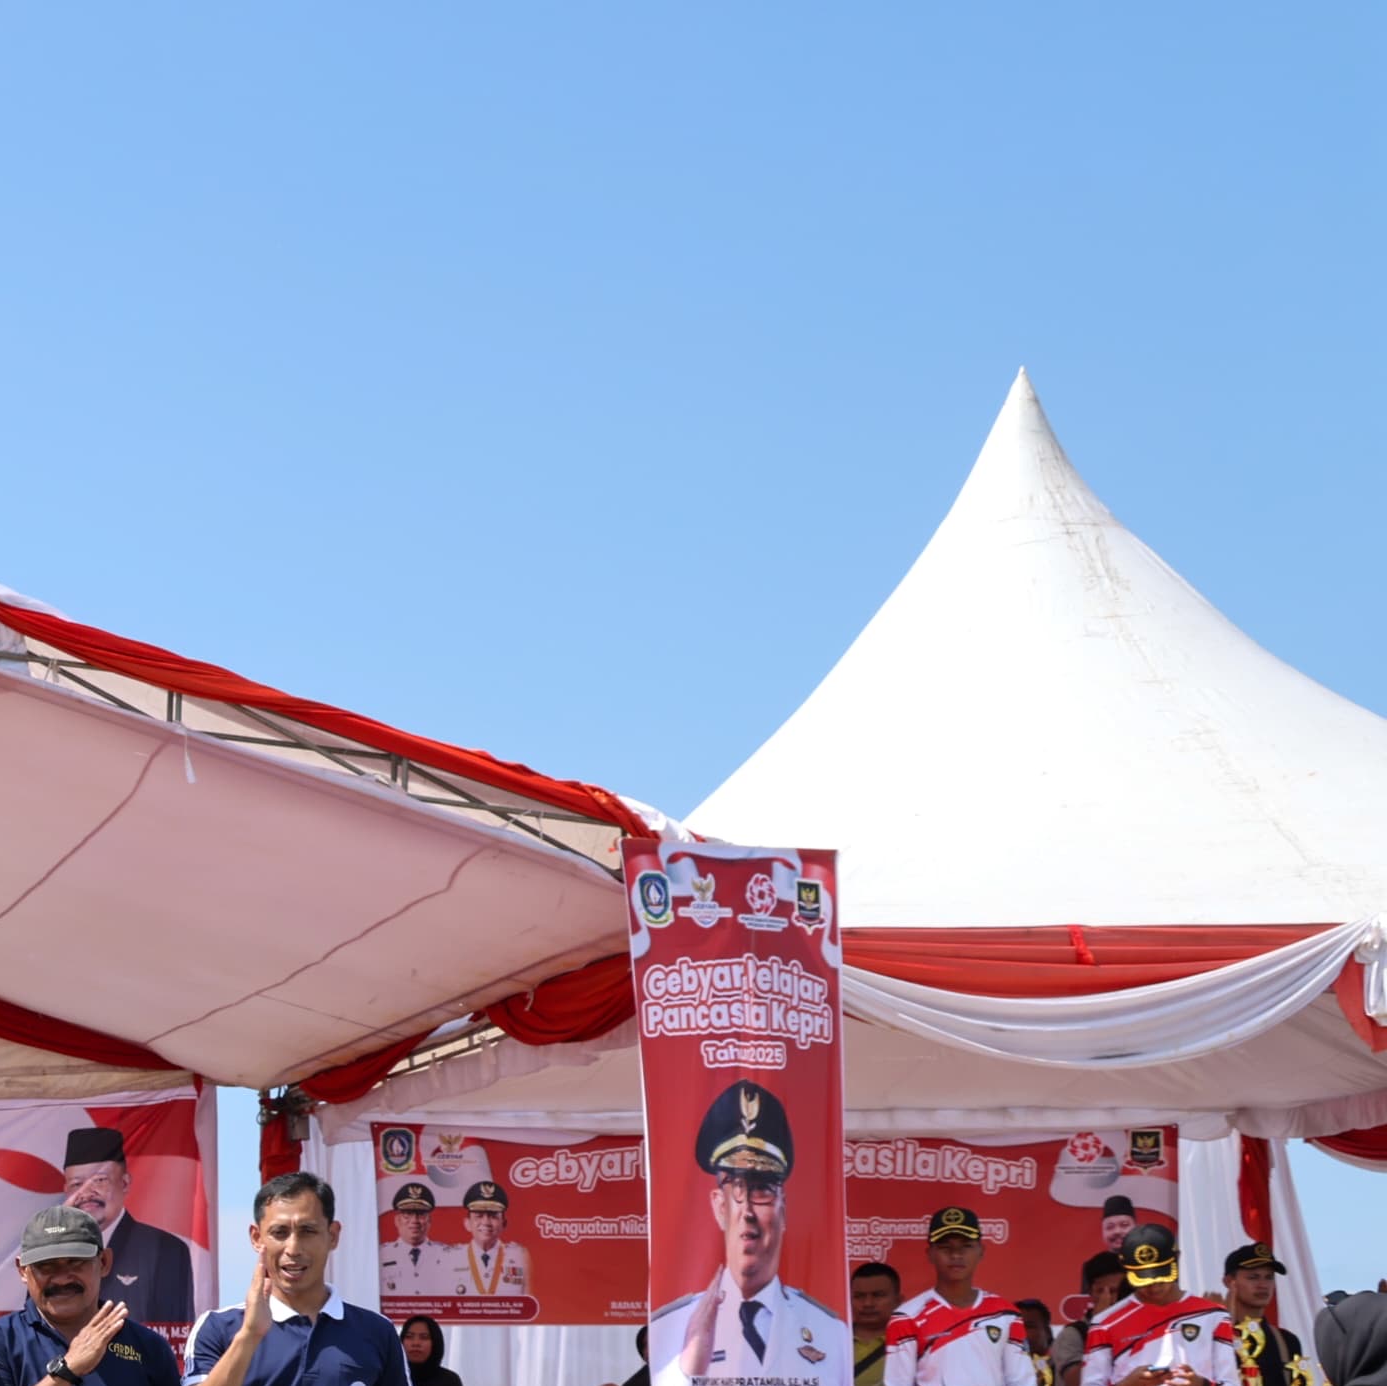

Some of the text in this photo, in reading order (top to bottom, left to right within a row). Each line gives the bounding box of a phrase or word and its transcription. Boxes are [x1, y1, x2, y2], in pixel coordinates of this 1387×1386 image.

[647, 958, 744, 996] Gebyar
[772, 1002, 829, 1045] Kepri
[749, 1048, 783, 1063] 2025
[514, 1152, 635, 1189] Gebyar
[944, 1148, 1034, 1190] Kepri
